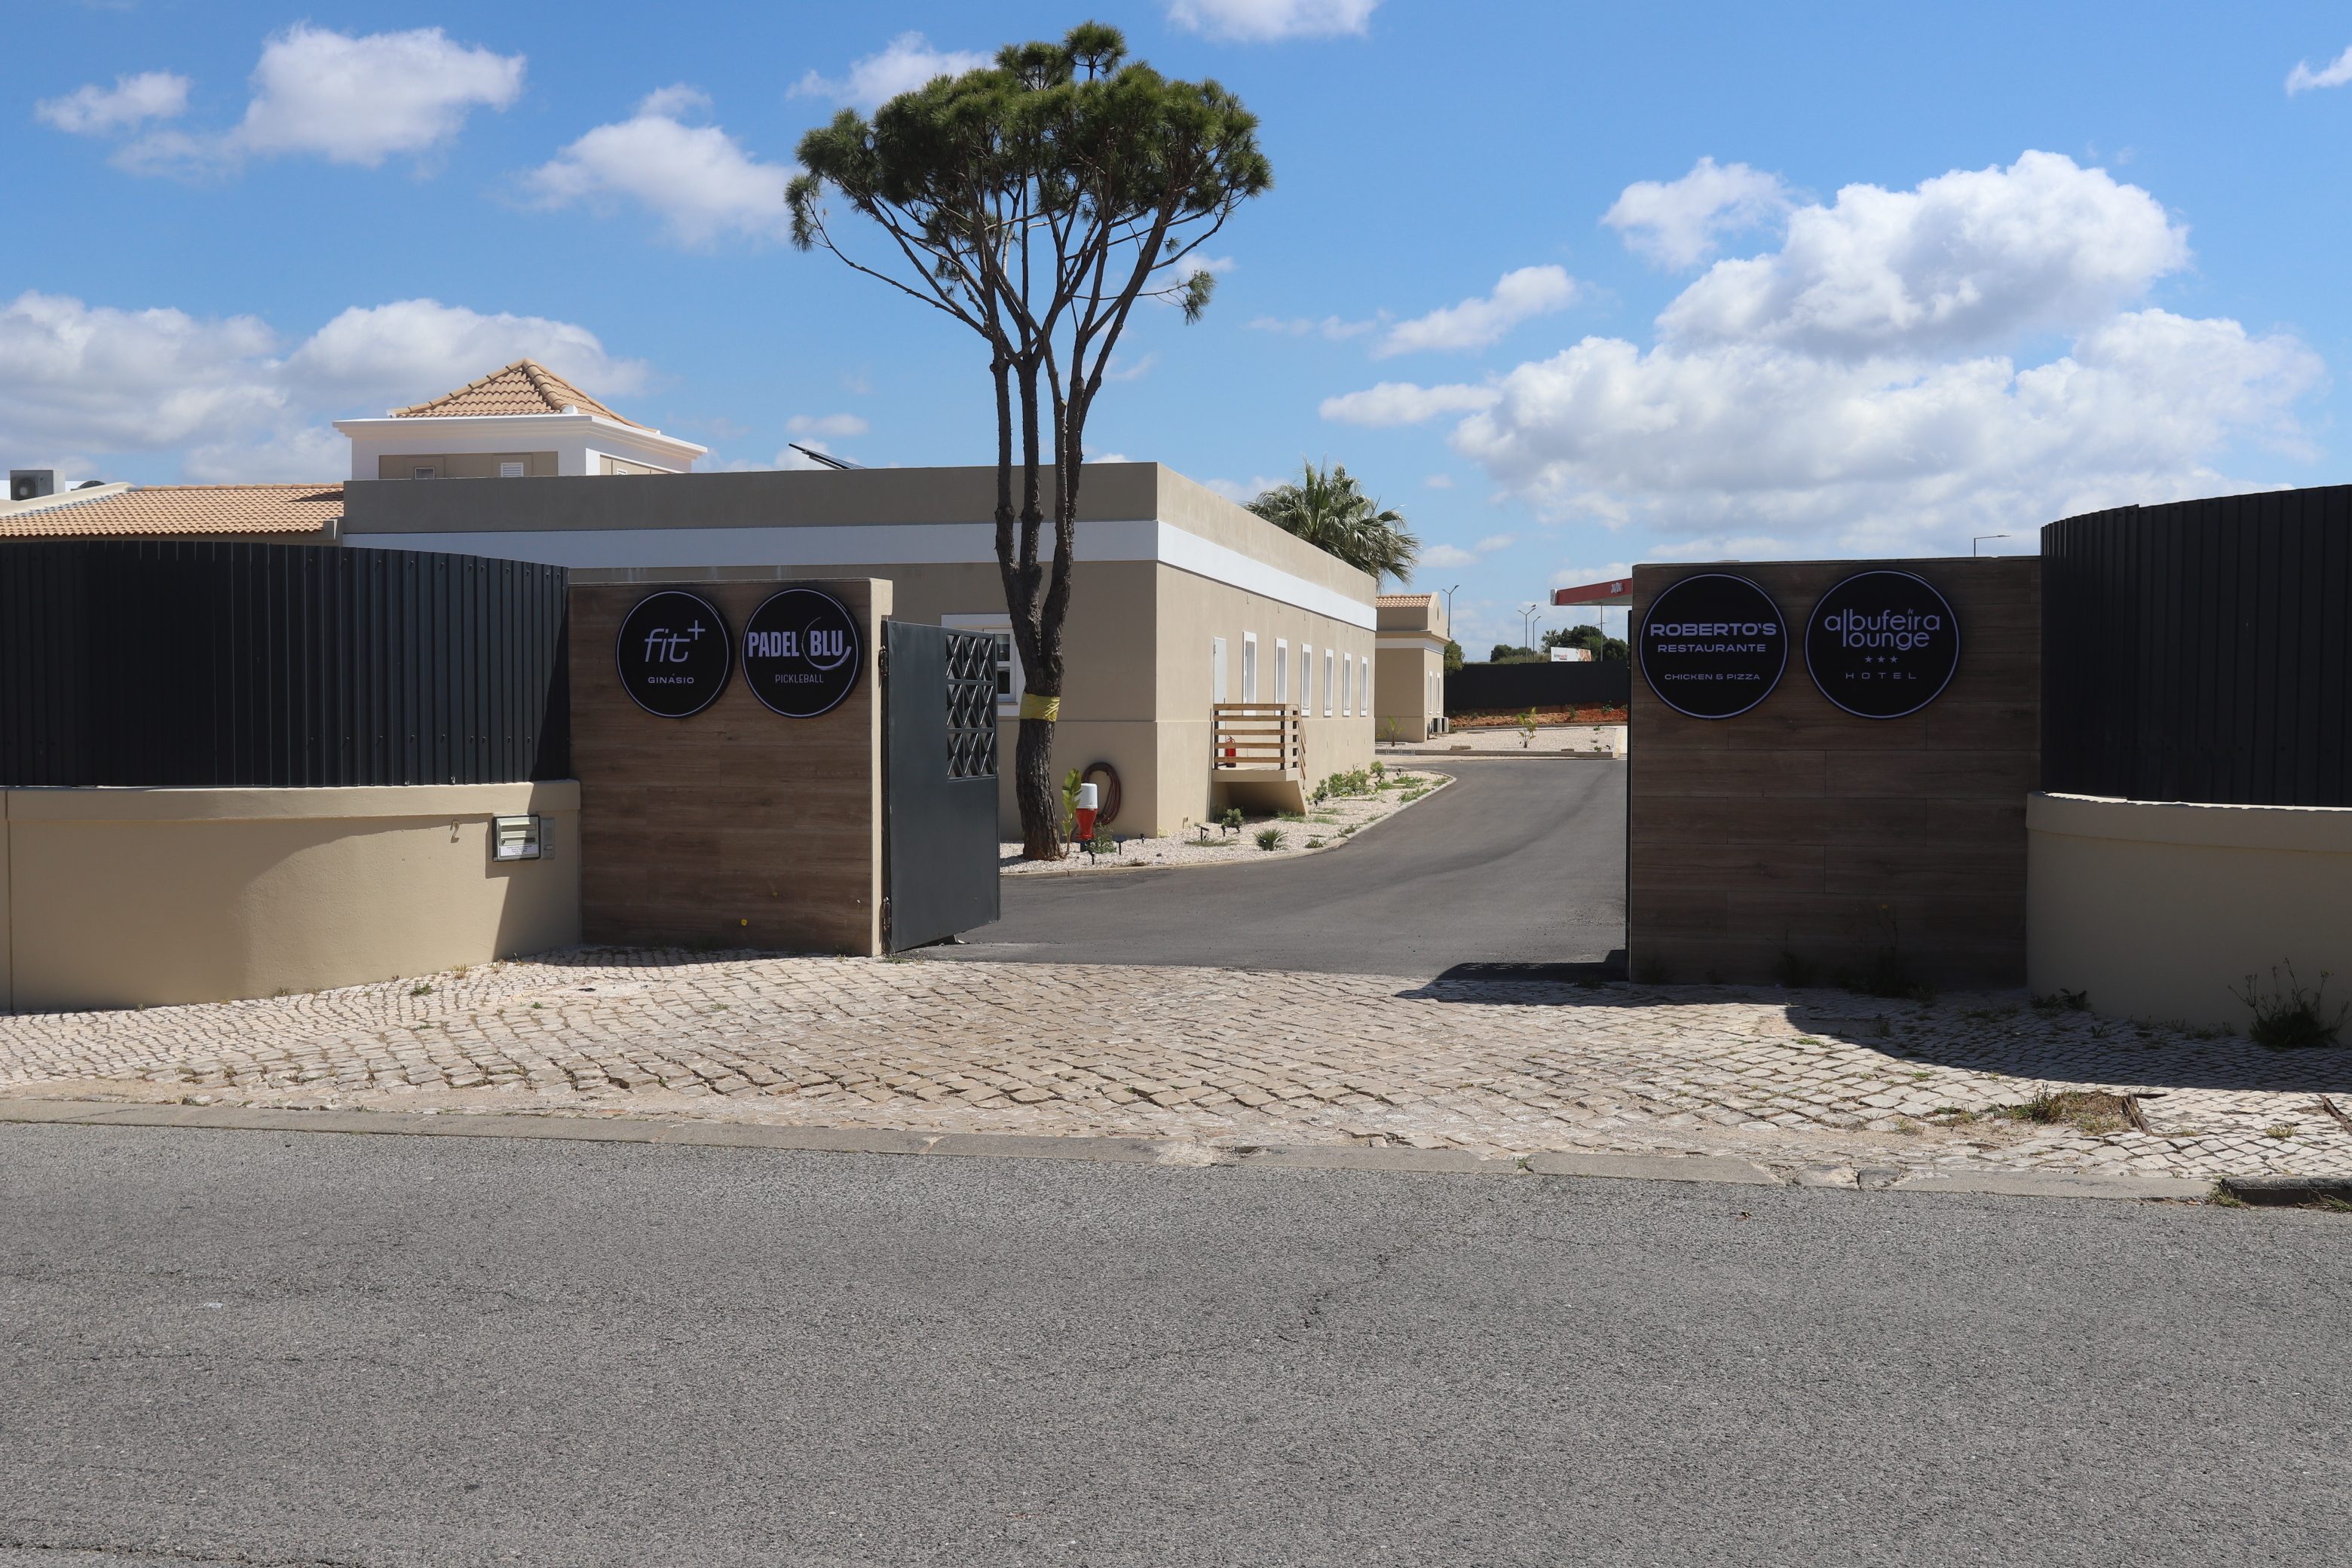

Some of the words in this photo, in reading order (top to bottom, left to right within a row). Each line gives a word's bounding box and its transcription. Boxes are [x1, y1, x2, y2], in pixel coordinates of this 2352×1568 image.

[1824, 608, 1940, 632] albufeira
[1650, 623, 1777, 637] ROBERTO'S
[1842, 627, 1931, 651] lounge
[747, 630, 800, 657] PADEL
[810, 629, 844, 657] BLU
[1658, 644, 1766, 653] RESTAURANTE
[648, 673, 695, 684] GINÁSIO
[775, 674, 824, 684] PICKLEBALL
[450, 820, 460, 843] 2
